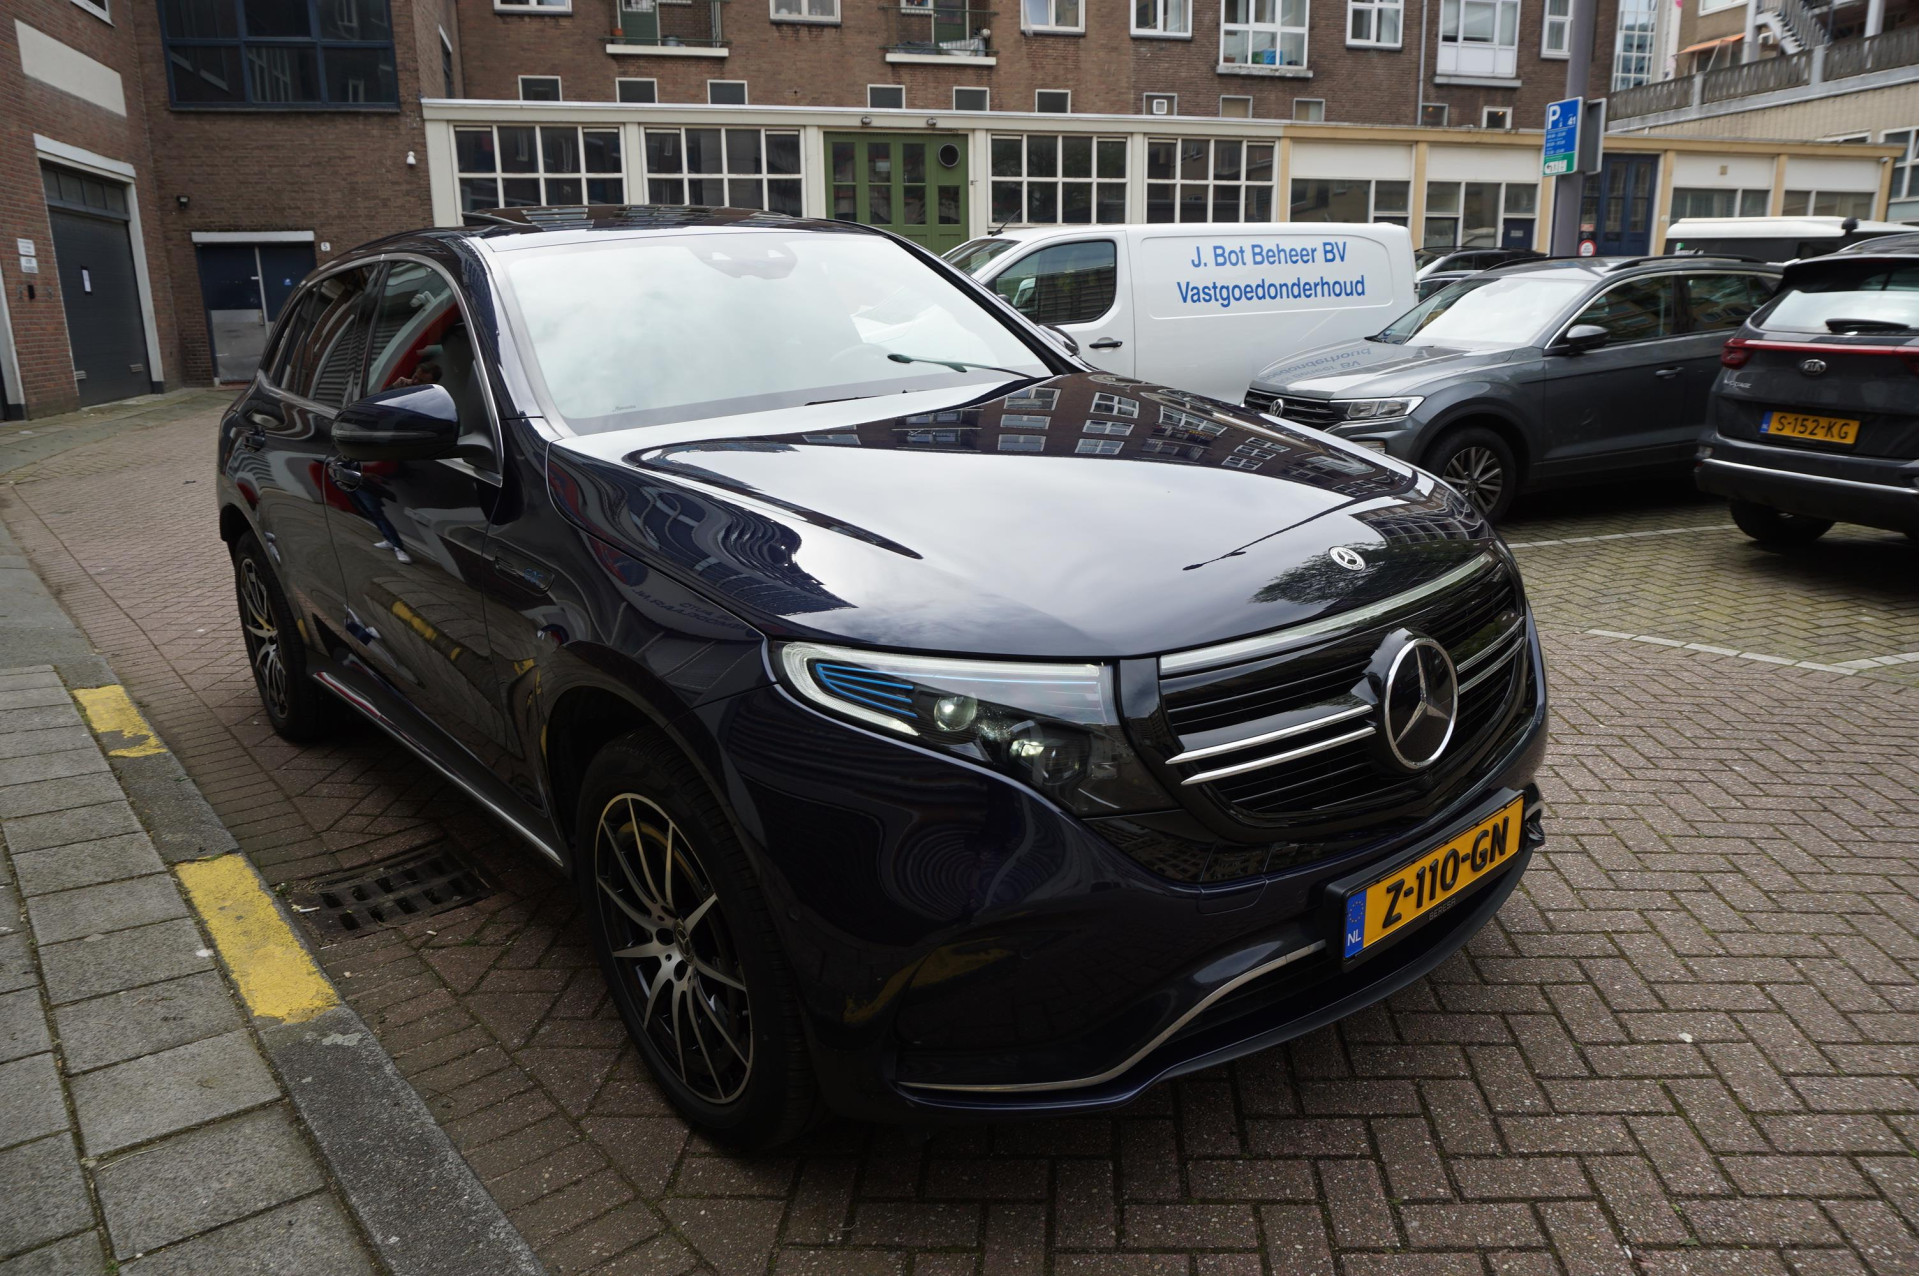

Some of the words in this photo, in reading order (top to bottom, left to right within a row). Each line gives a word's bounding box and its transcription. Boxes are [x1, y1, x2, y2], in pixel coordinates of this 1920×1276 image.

[1548, 105, 1560, 129] P
[1191, 246, 1208, 268] J.
[1212, 245, 1247, 267] Bot
[1250, 243, 1318, 266] Beheer
[1322, 241, 1347, 263] BV
[1176, 274, 1367, 308] Vastgoedonderhoud
[1775, 415, 1851, 440] S-152-KG
[1382, 816, 1510, 929] Z-110-GN
[1347, 929, 1362, 947] NL
